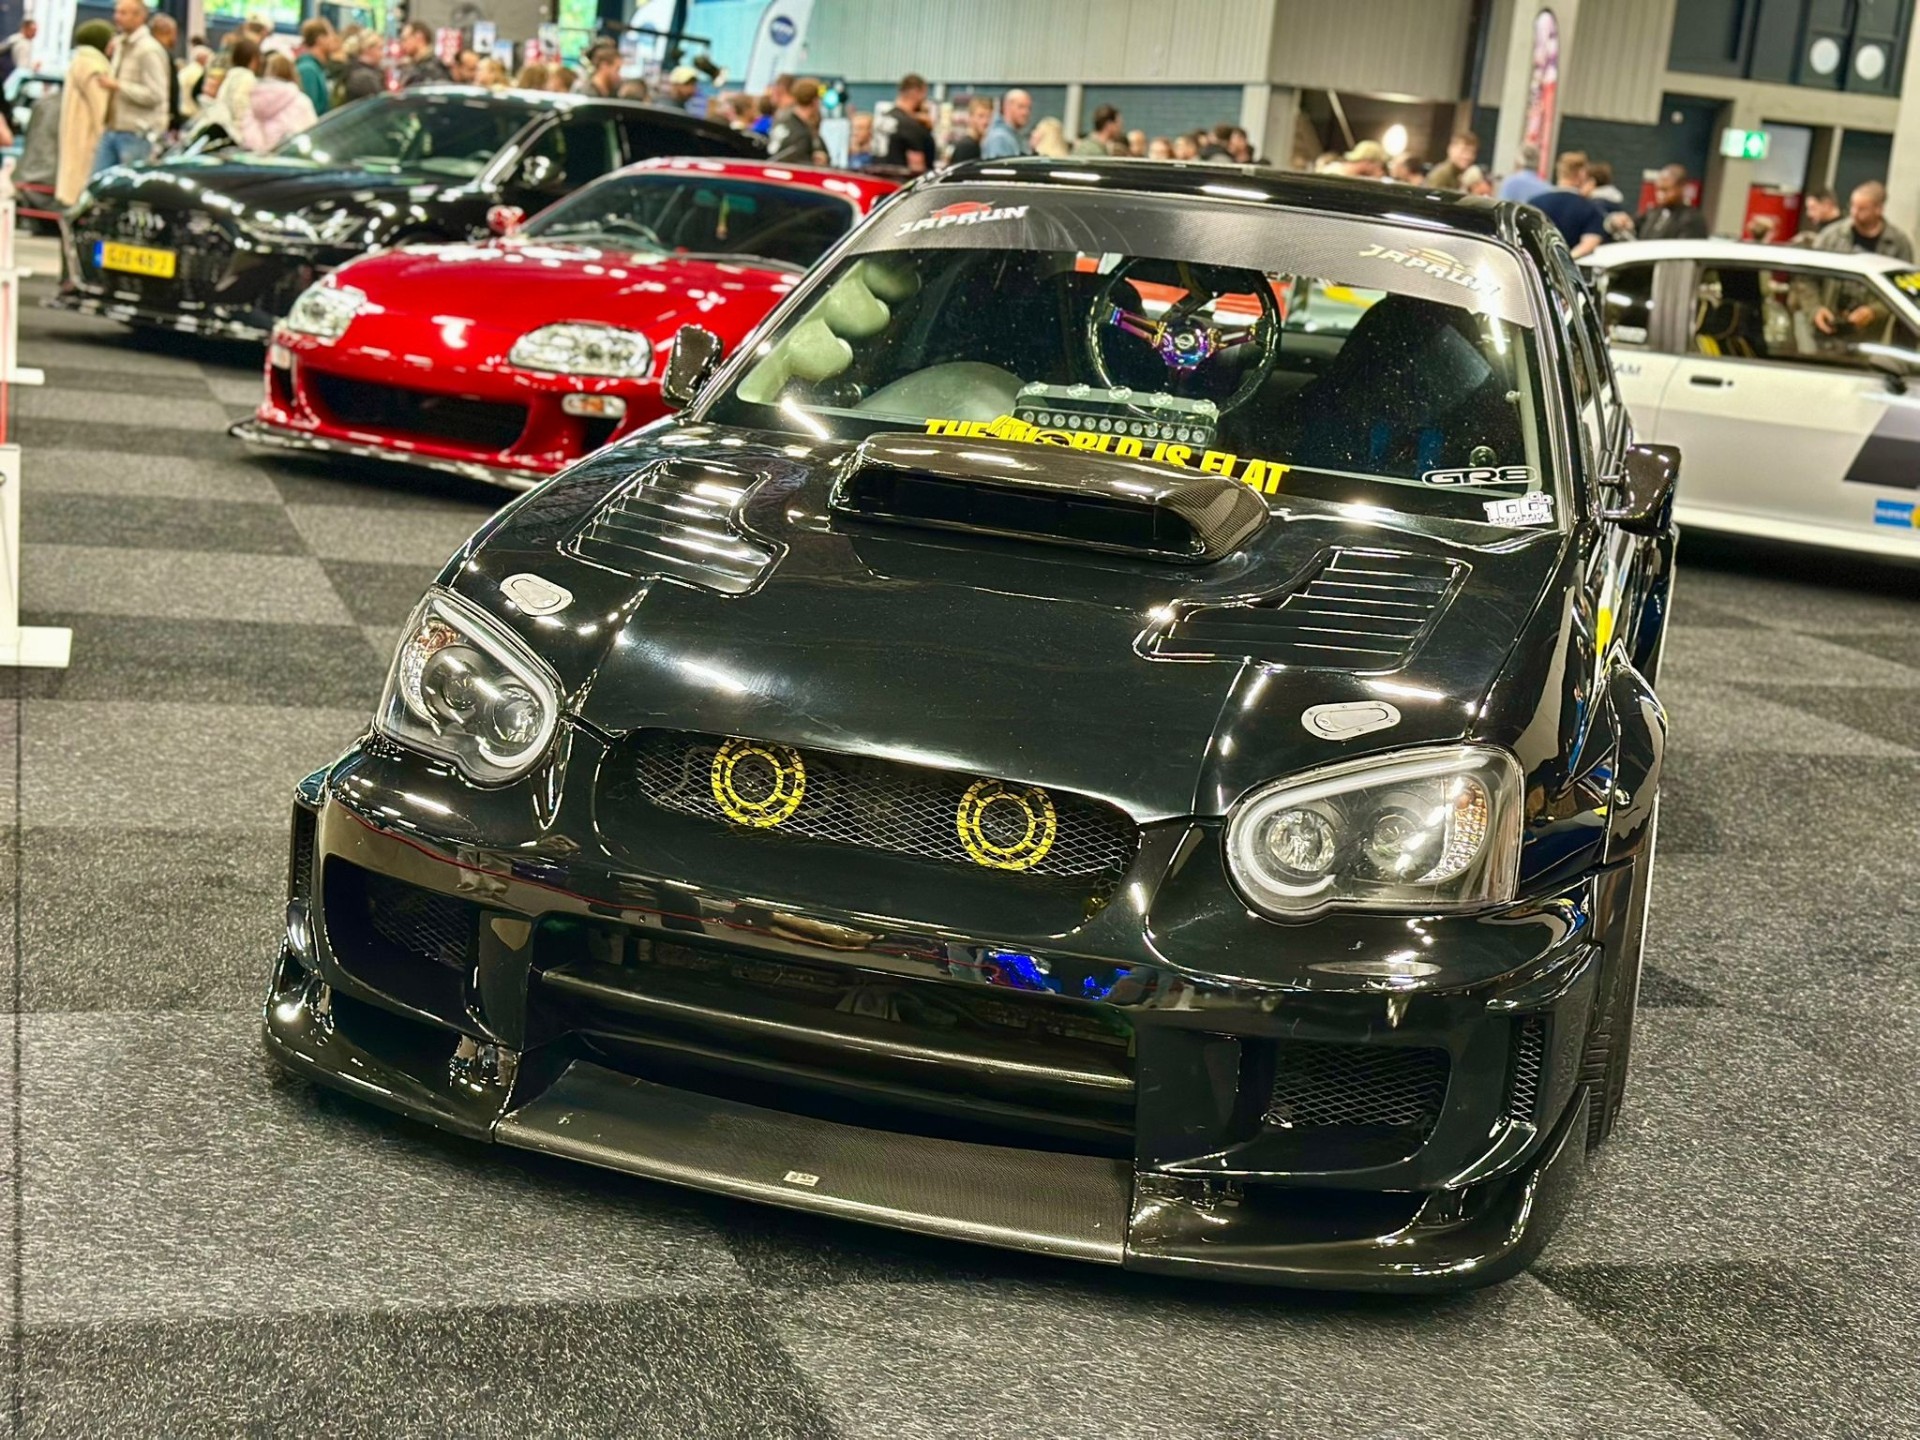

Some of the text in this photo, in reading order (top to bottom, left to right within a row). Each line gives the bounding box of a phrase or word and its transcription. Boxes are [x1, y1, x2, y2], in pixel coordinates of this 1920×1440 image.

[895, 205, 1029, 237] JAPRUN
[925, 418, 991, 438] THE
[1151, 442, 1192, 467] IS
[1199, 449, 1291, 495] FLAT
